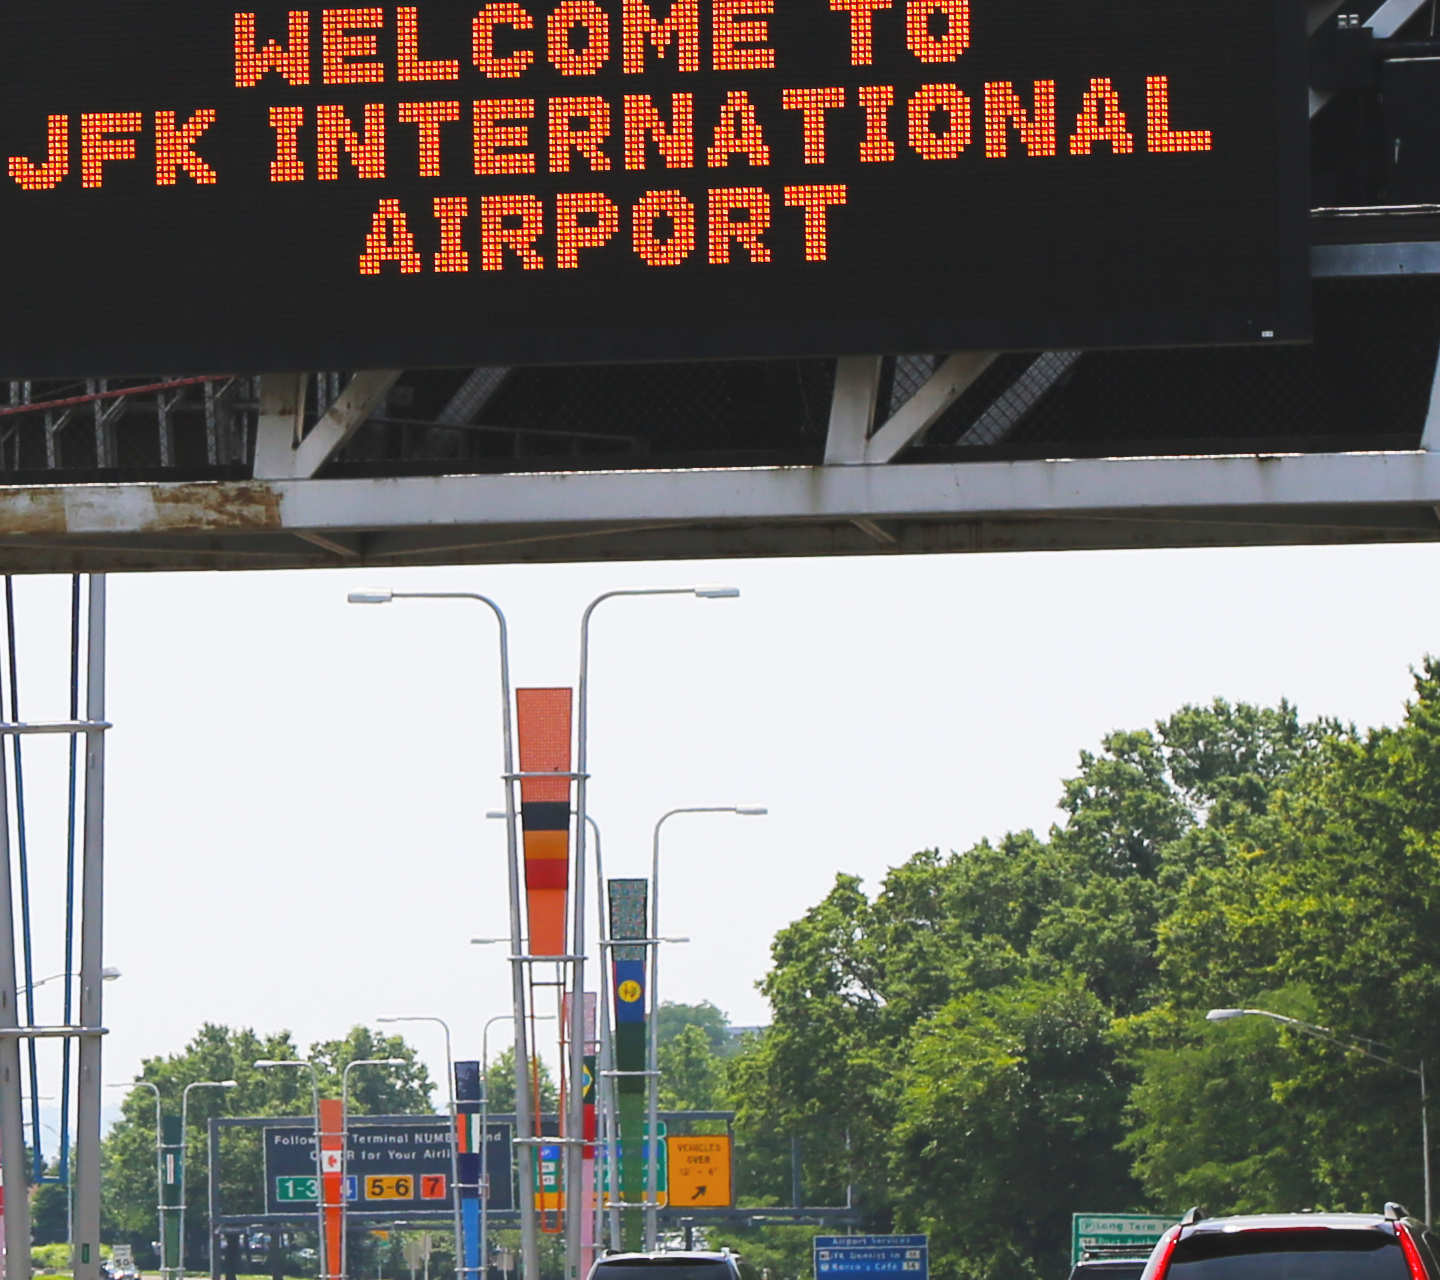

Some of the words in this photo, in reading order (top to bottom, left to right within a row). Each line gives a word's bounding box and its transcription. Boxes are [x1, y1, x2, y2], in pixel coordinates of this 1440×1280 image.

[8, 109, 216, 190] JFK
[268, 76, 1212, 182] INTERNATIONAL
[359, 185, 848, 274] AIRPORT
[352, 1133, 408, 1144] Terminal
[361, 1150, 381, 1160] for
[388, 1150, 416, 1160] Your
[687, 1155, 710, 1164] OVER
[371, 1178, 409, 1197] 5-6
[427, 1178, 440, 1196] 7
[1097, 1222, 1123, 1232] Long
[1129, 1222, 1156, 1230] Term
